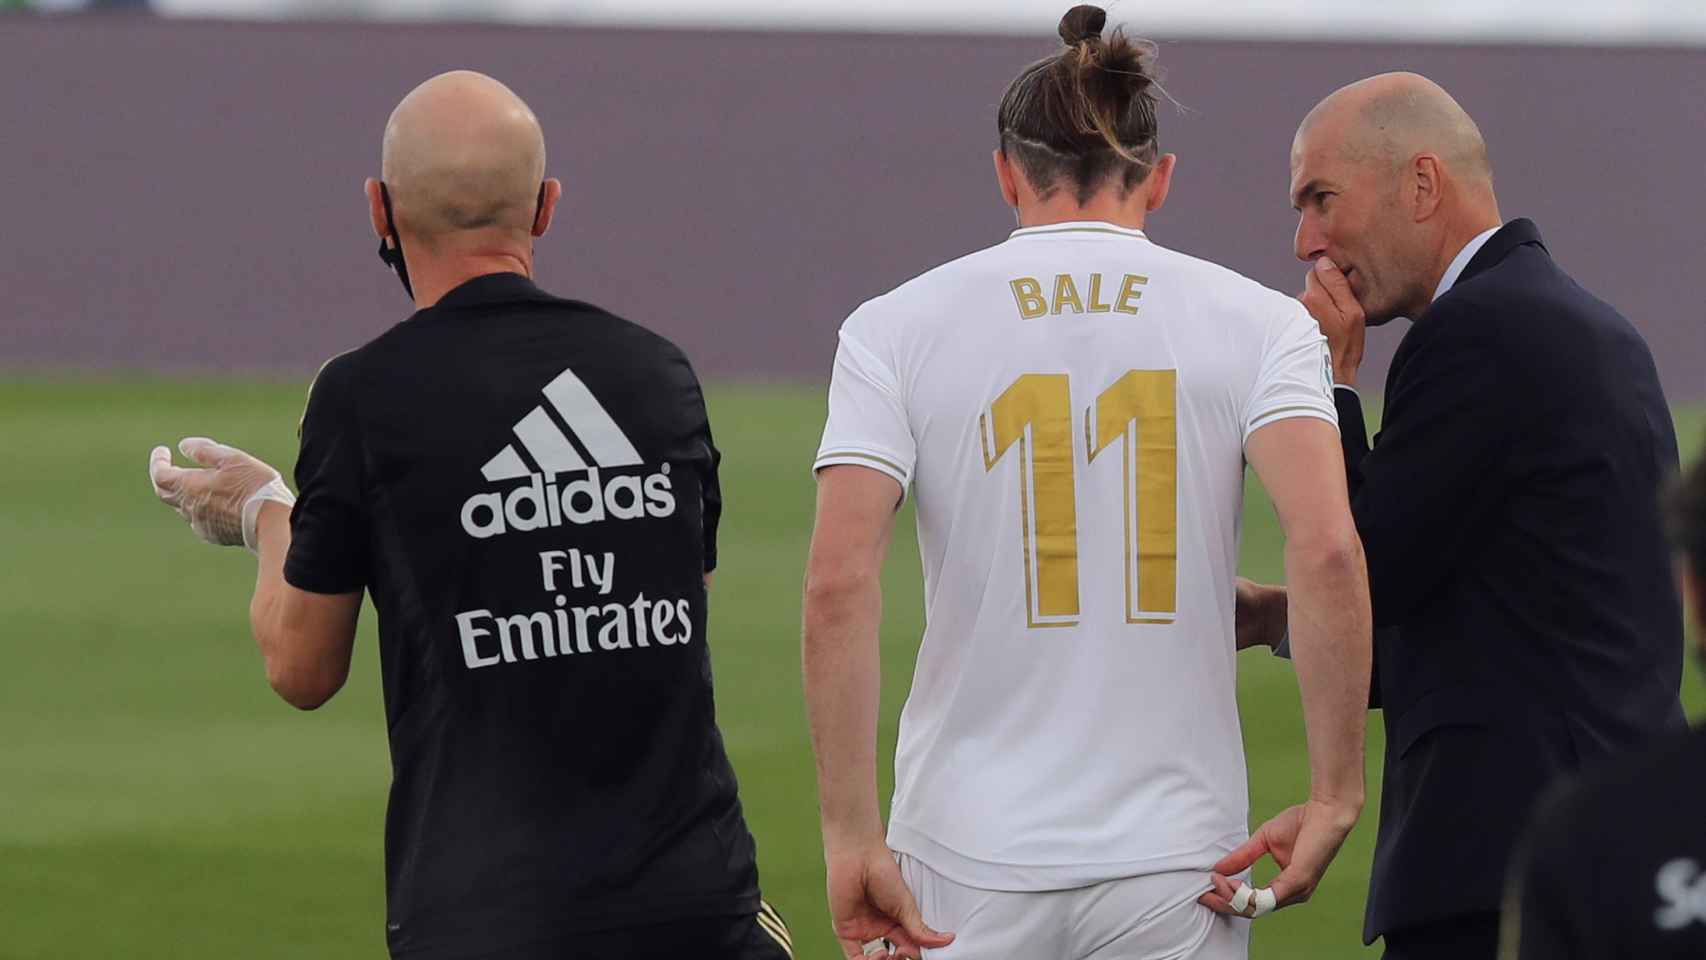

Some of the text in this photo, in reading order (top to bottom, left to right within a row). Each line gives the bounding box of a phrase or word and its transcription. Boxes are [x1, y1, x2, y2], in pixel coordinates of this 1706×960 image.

[1009, 273, 1148, 320] BALE
[460, 466, 676, 538] adidas
[979, 369, 1177, 628] 11
[539, 548, 615, 594] Fly
[455, 592, 692, 669] Emirates
